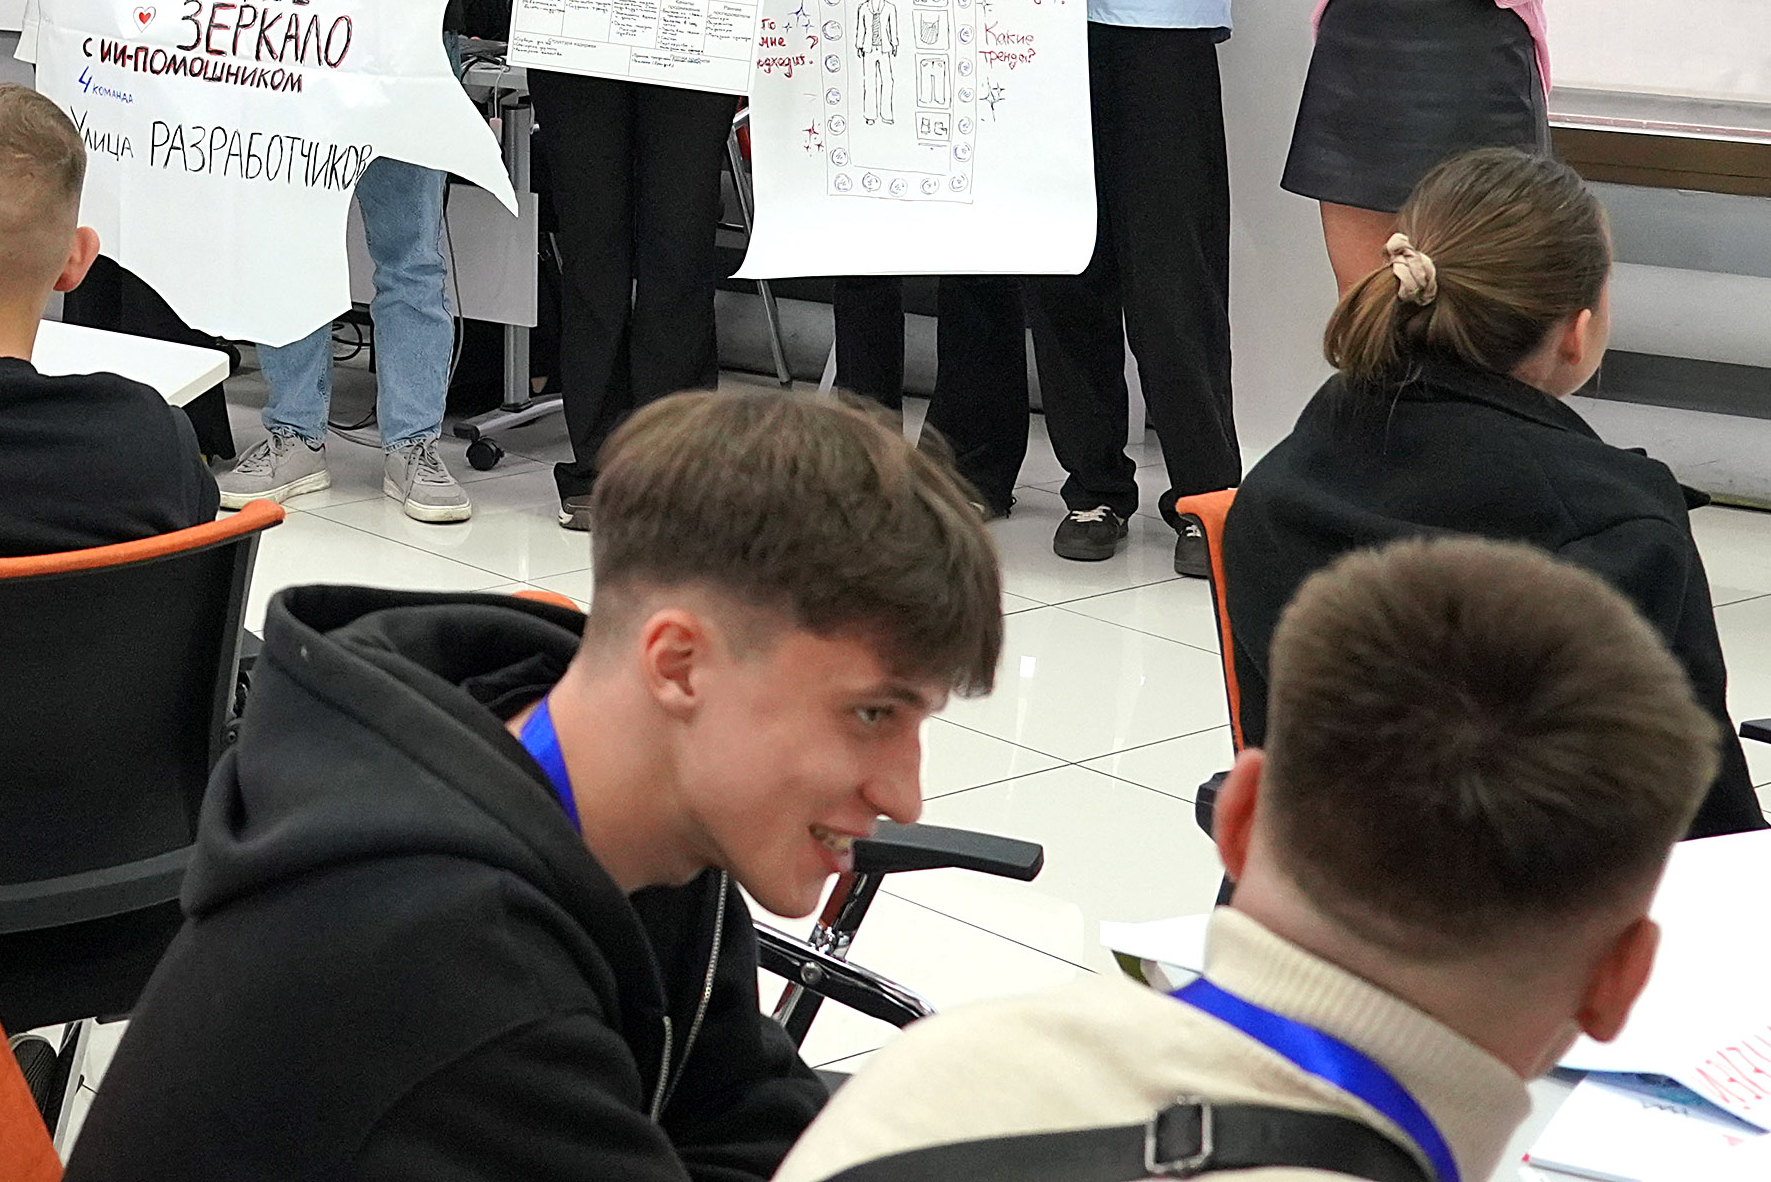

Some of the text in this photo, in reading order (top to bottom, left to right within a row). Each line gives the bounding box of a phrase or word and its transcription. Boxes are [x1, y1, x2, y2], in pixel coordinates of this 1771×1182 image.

[984, 21, 1034, 46] Какие
[78, 66, 93, 94] 4
[150, 120, 373, 191] РАЗРАБОТЧИКОВ
